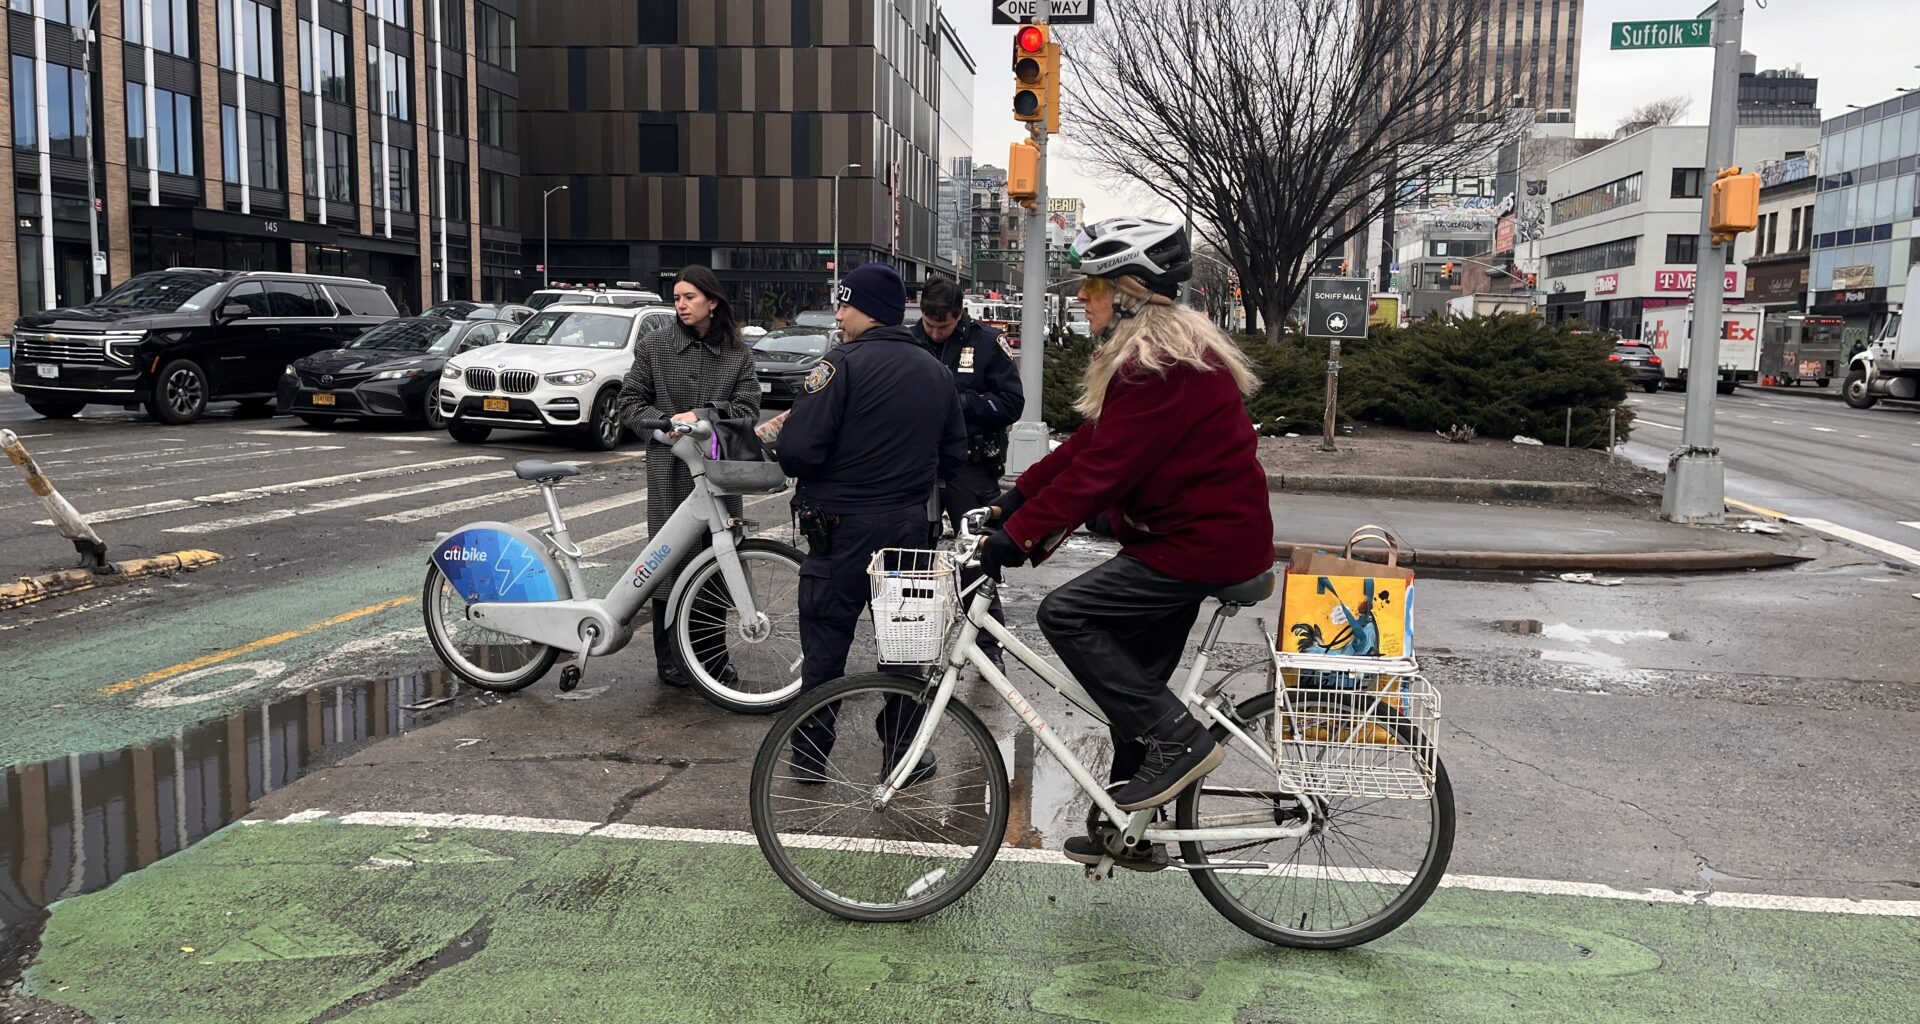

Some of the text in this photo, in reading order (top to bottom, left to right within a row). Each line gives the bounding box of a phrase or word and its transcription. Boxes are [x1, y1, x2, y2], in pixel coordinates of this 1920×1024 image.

[1008, 1, 1081, 14] ONE WAY
[1621, 23, 1703, 46] Suffolk St
[265, 221, 278, 233] 145
[1096, 251, 1140, 271] SPECIALIZED
[1315, 292, 1363, 301] SCHIFF MALL
[1007, 689, 1045, 732] CIVIA
